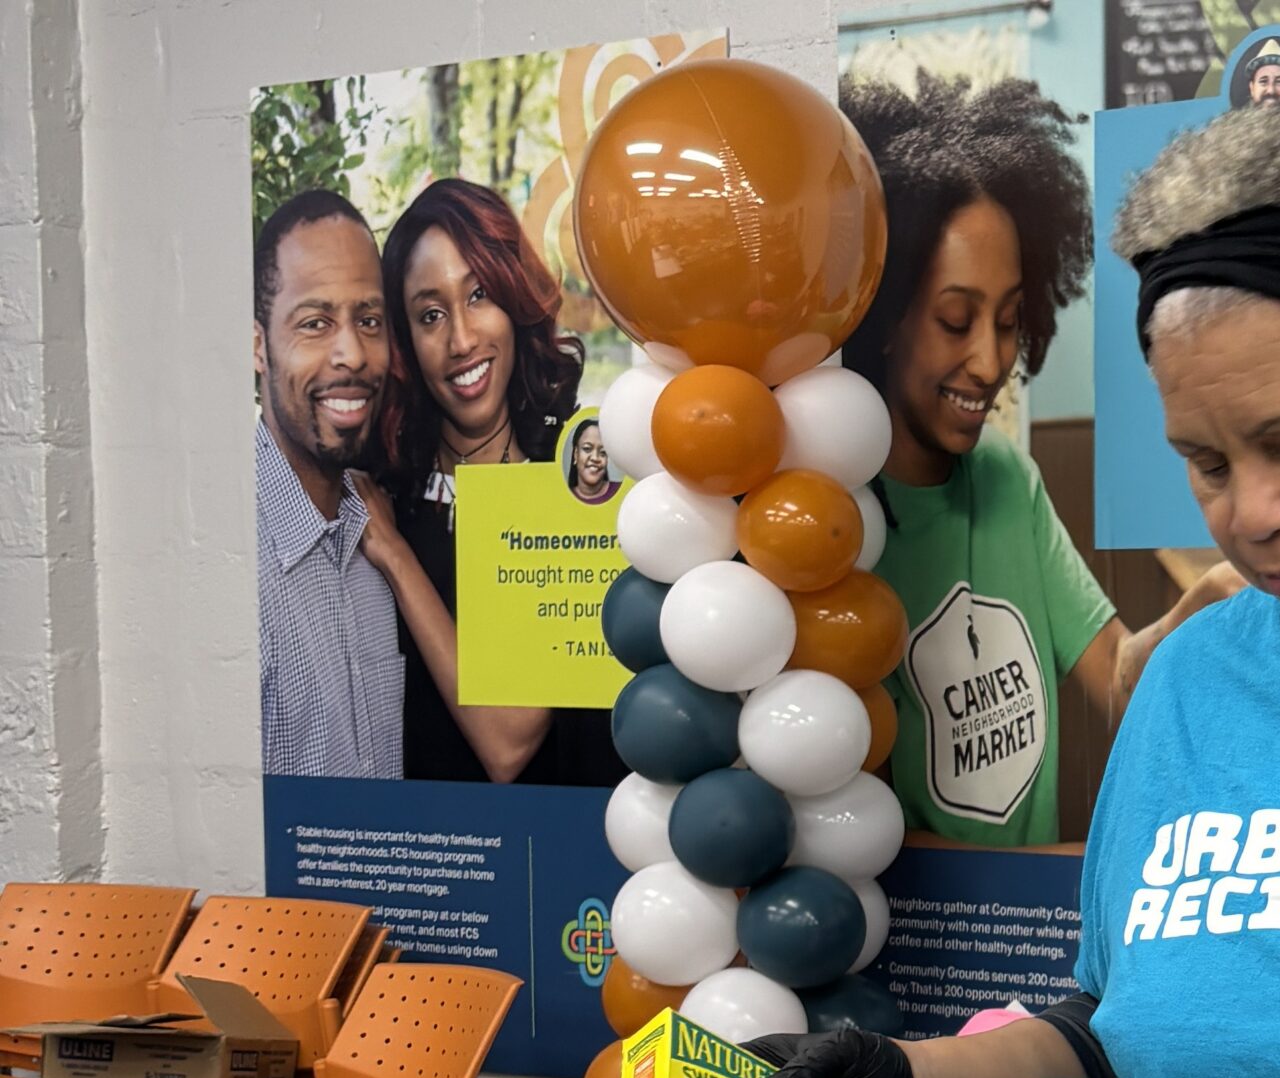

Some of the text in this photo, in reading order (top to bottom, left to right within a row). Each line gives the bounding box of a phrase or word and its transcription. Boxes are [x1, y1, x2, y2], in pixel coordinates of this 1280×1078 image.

[501, 531, 621, 550] “Homeowner
[498, 565, 621, 588] brought me co
[538, 599, 601, 621] and pur
[943, 660, 1030, 721] CARVER
[954, 711, 1036, 777] MARKET
[364, 829, 483, 847] important healthy families
[409, 849, 484, 864] housing programs
[364, 864, 461, 881] opportunity purchase
[385, 906, 488, 923] program below
[944, 903, 1081, 921] gather Community Grou
[418, 926, 479, 939] and most FCS
[993, 925, 1064, 938] another while
[416, 941, 497, 958] homes using down
[945, 939, 1067, 959] other healthy offerings.
[889, 962, 1048, 985] Community Grounds serves 200
[910, 982, 1032, 1004] That opportunities
[61, 1041, 111, 1059] ULINE
